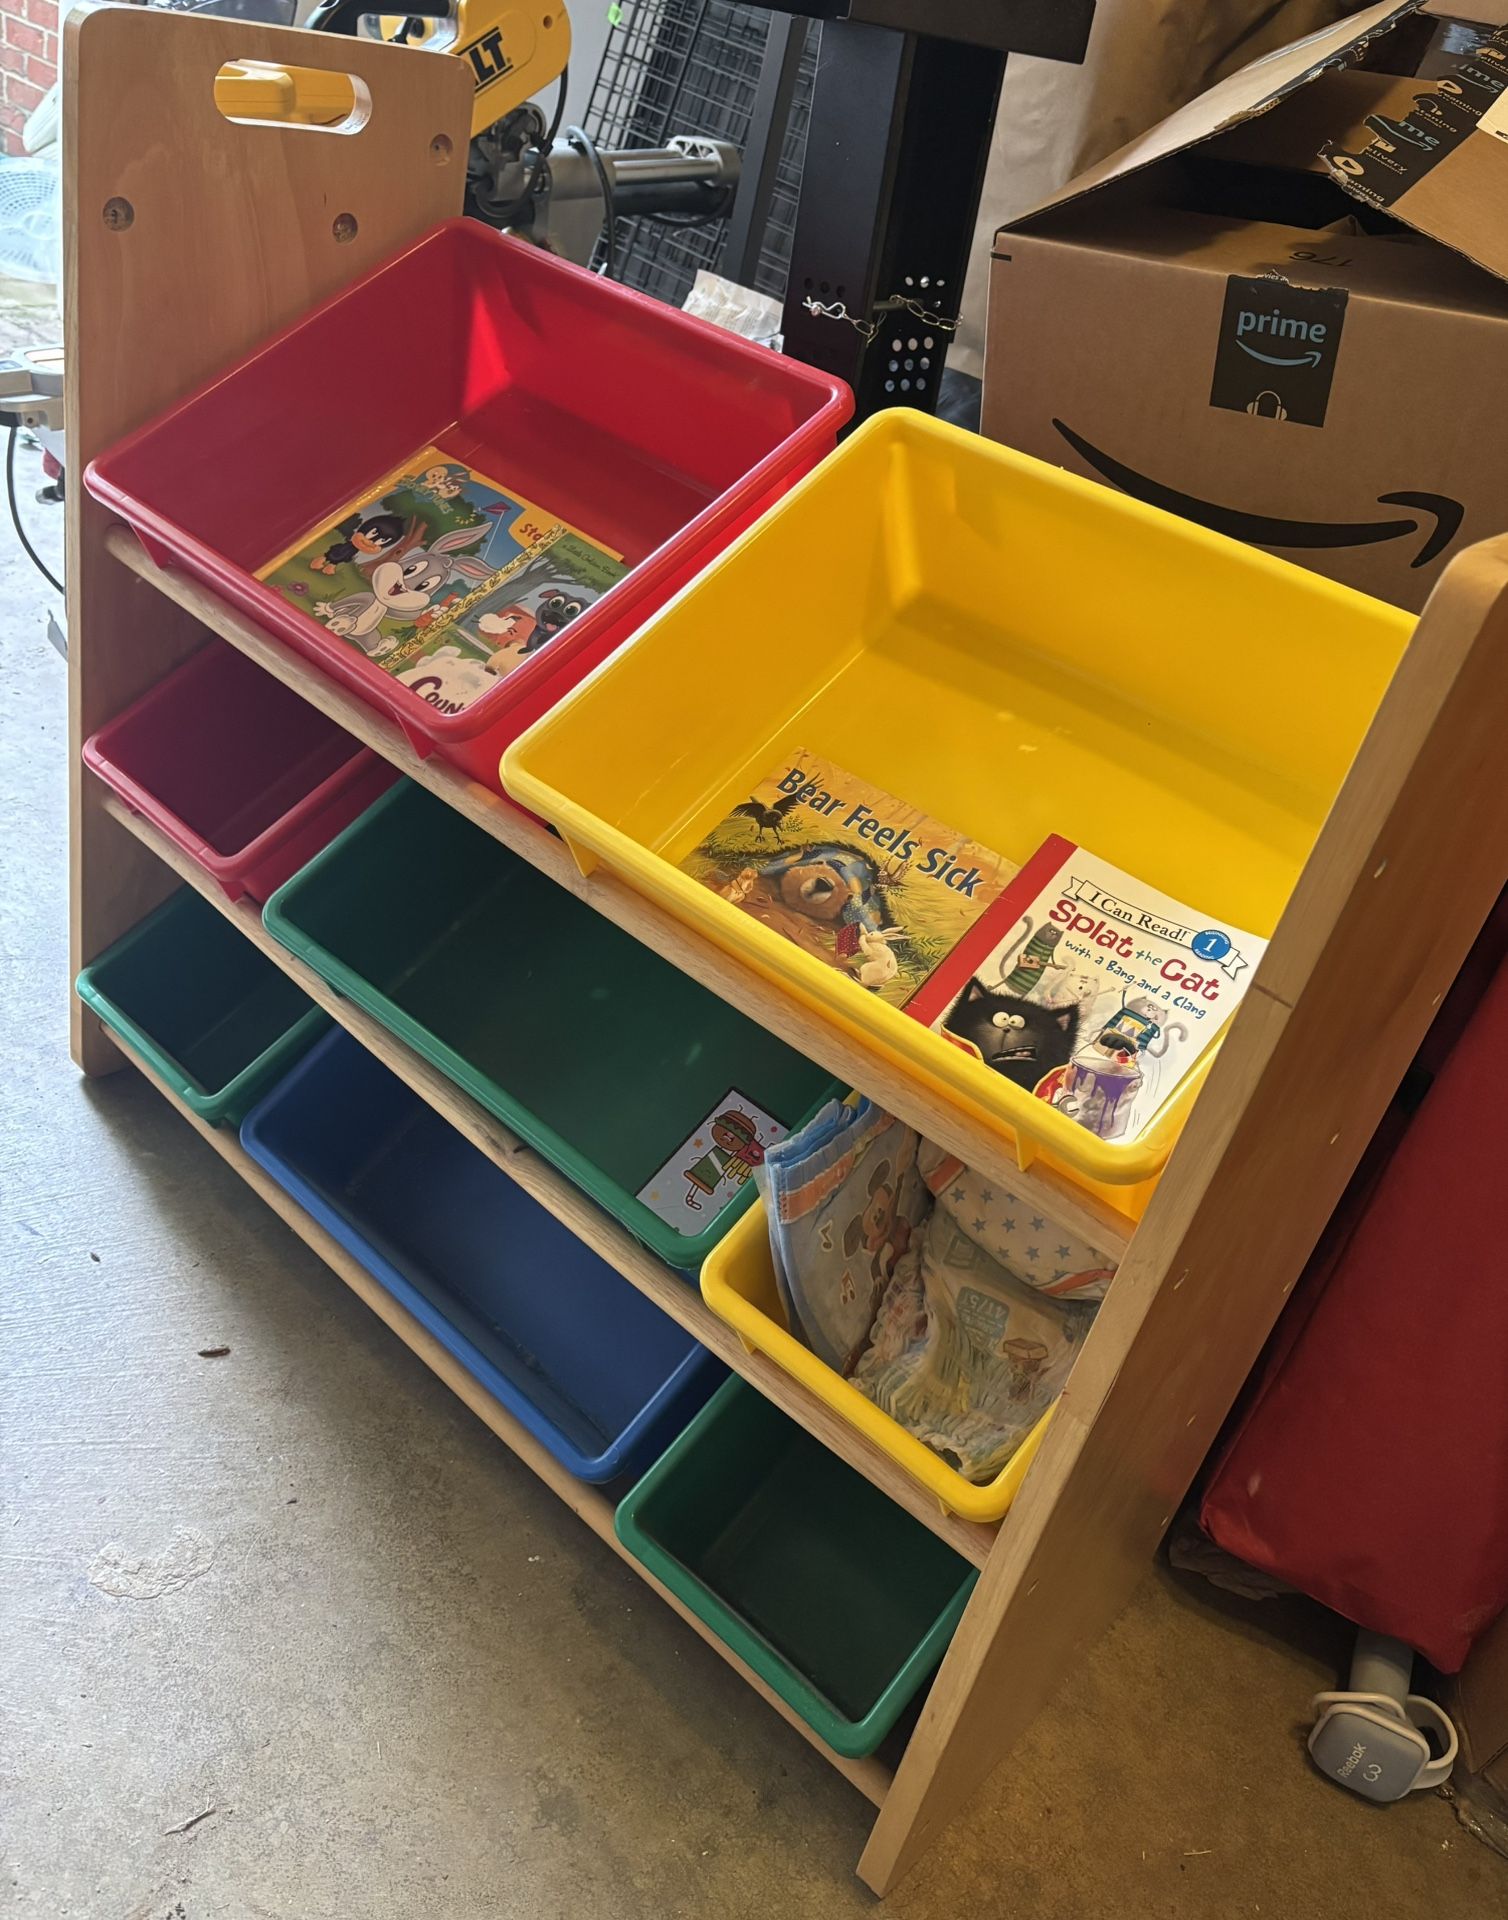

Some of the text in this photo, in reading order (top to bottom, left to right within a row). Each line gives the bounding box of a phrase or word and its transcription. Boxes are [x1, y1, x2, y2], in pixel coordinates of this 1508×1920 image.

[1366, 147, 1408, 172] elivery
[1236, 309, 1327, 343] prime
[777, 768, 984, 899] Bear Feels Sick
[1089, 891, 1187, 942] I Can Read!
[1049, 899, 1222, 1001] Splat the Cat
[1203, 938, 1218, 953] 1
[1065, 939, 1207, 1020] with a Bang and a Clang
[1336, 1742, 1367, 1779] Reebok
[1363, 1763, 1382, 1783] 3
